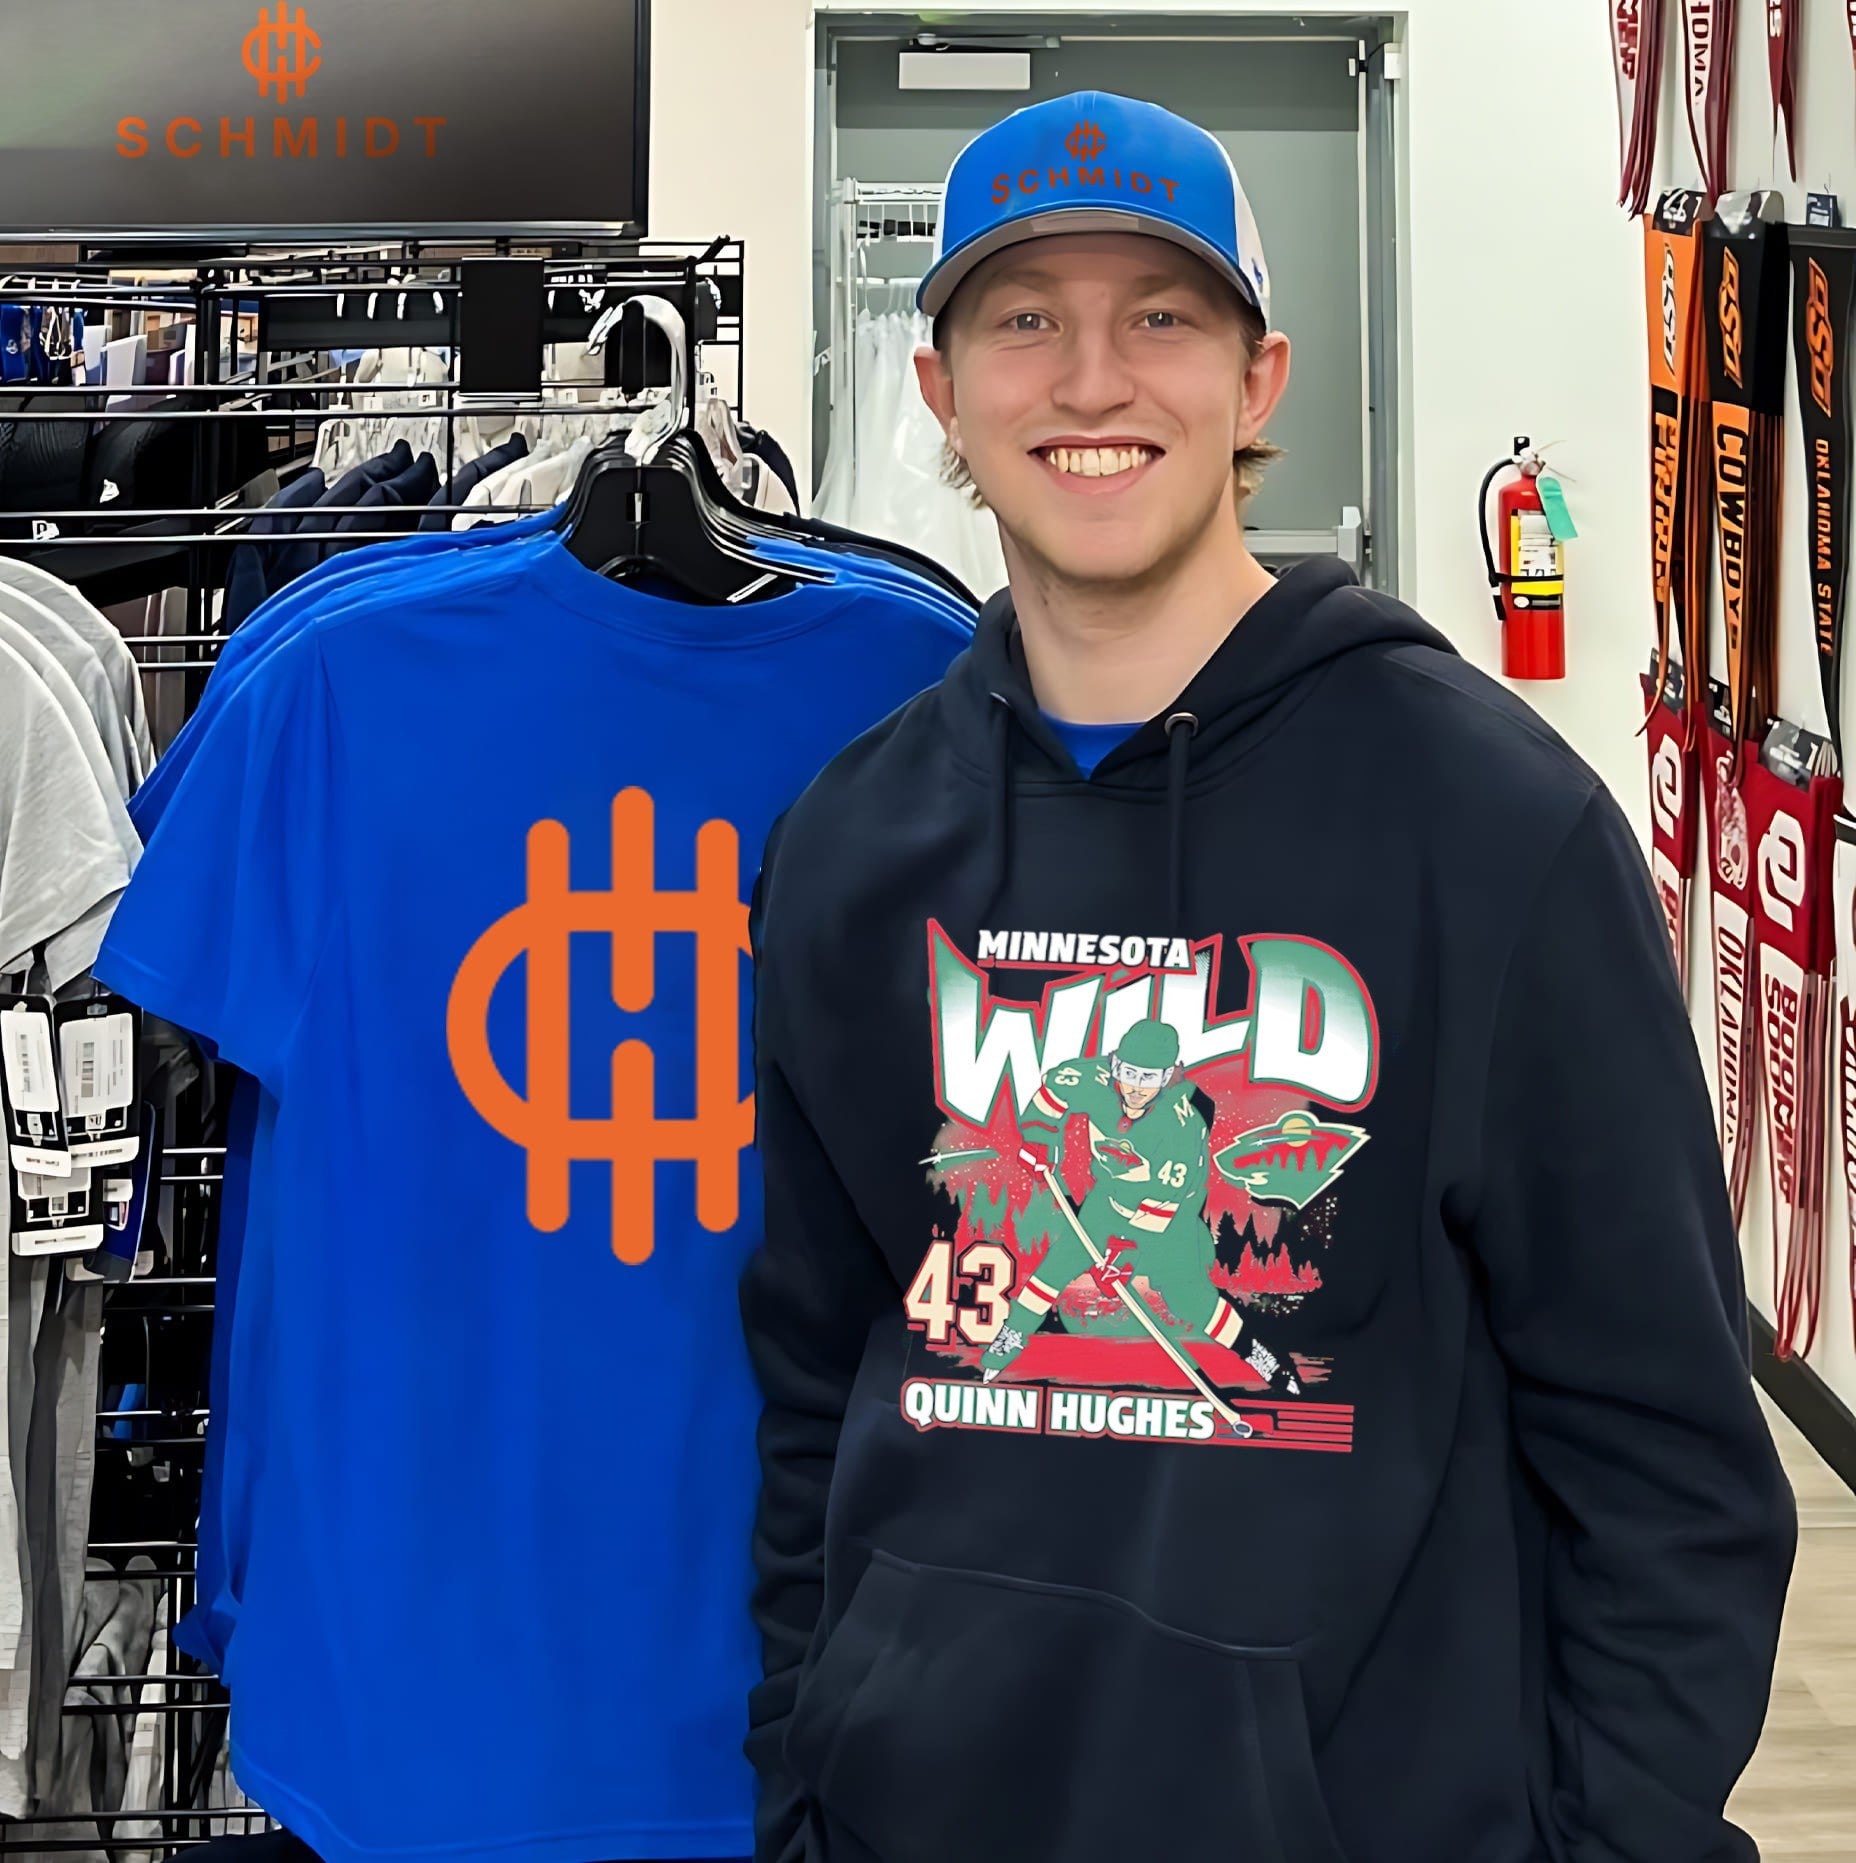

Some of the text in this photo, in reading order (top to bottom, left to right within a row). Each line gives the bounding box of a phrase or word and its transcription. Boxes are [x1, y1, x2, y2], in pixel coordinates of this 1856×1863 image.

[116, 117, 447, 158] SCHMIDT
[991, 167, 1180, 205] SCHMIDT
[977, 929, 1190, 969] MINNESOTA
[927, 920, 1379, 1130] WILD
[1157, 1159, 1188, 1189] 43
[904, 1240, 1016, 1346] 43
[904, 1381, 1216, 1440] QUINN HUGHES
